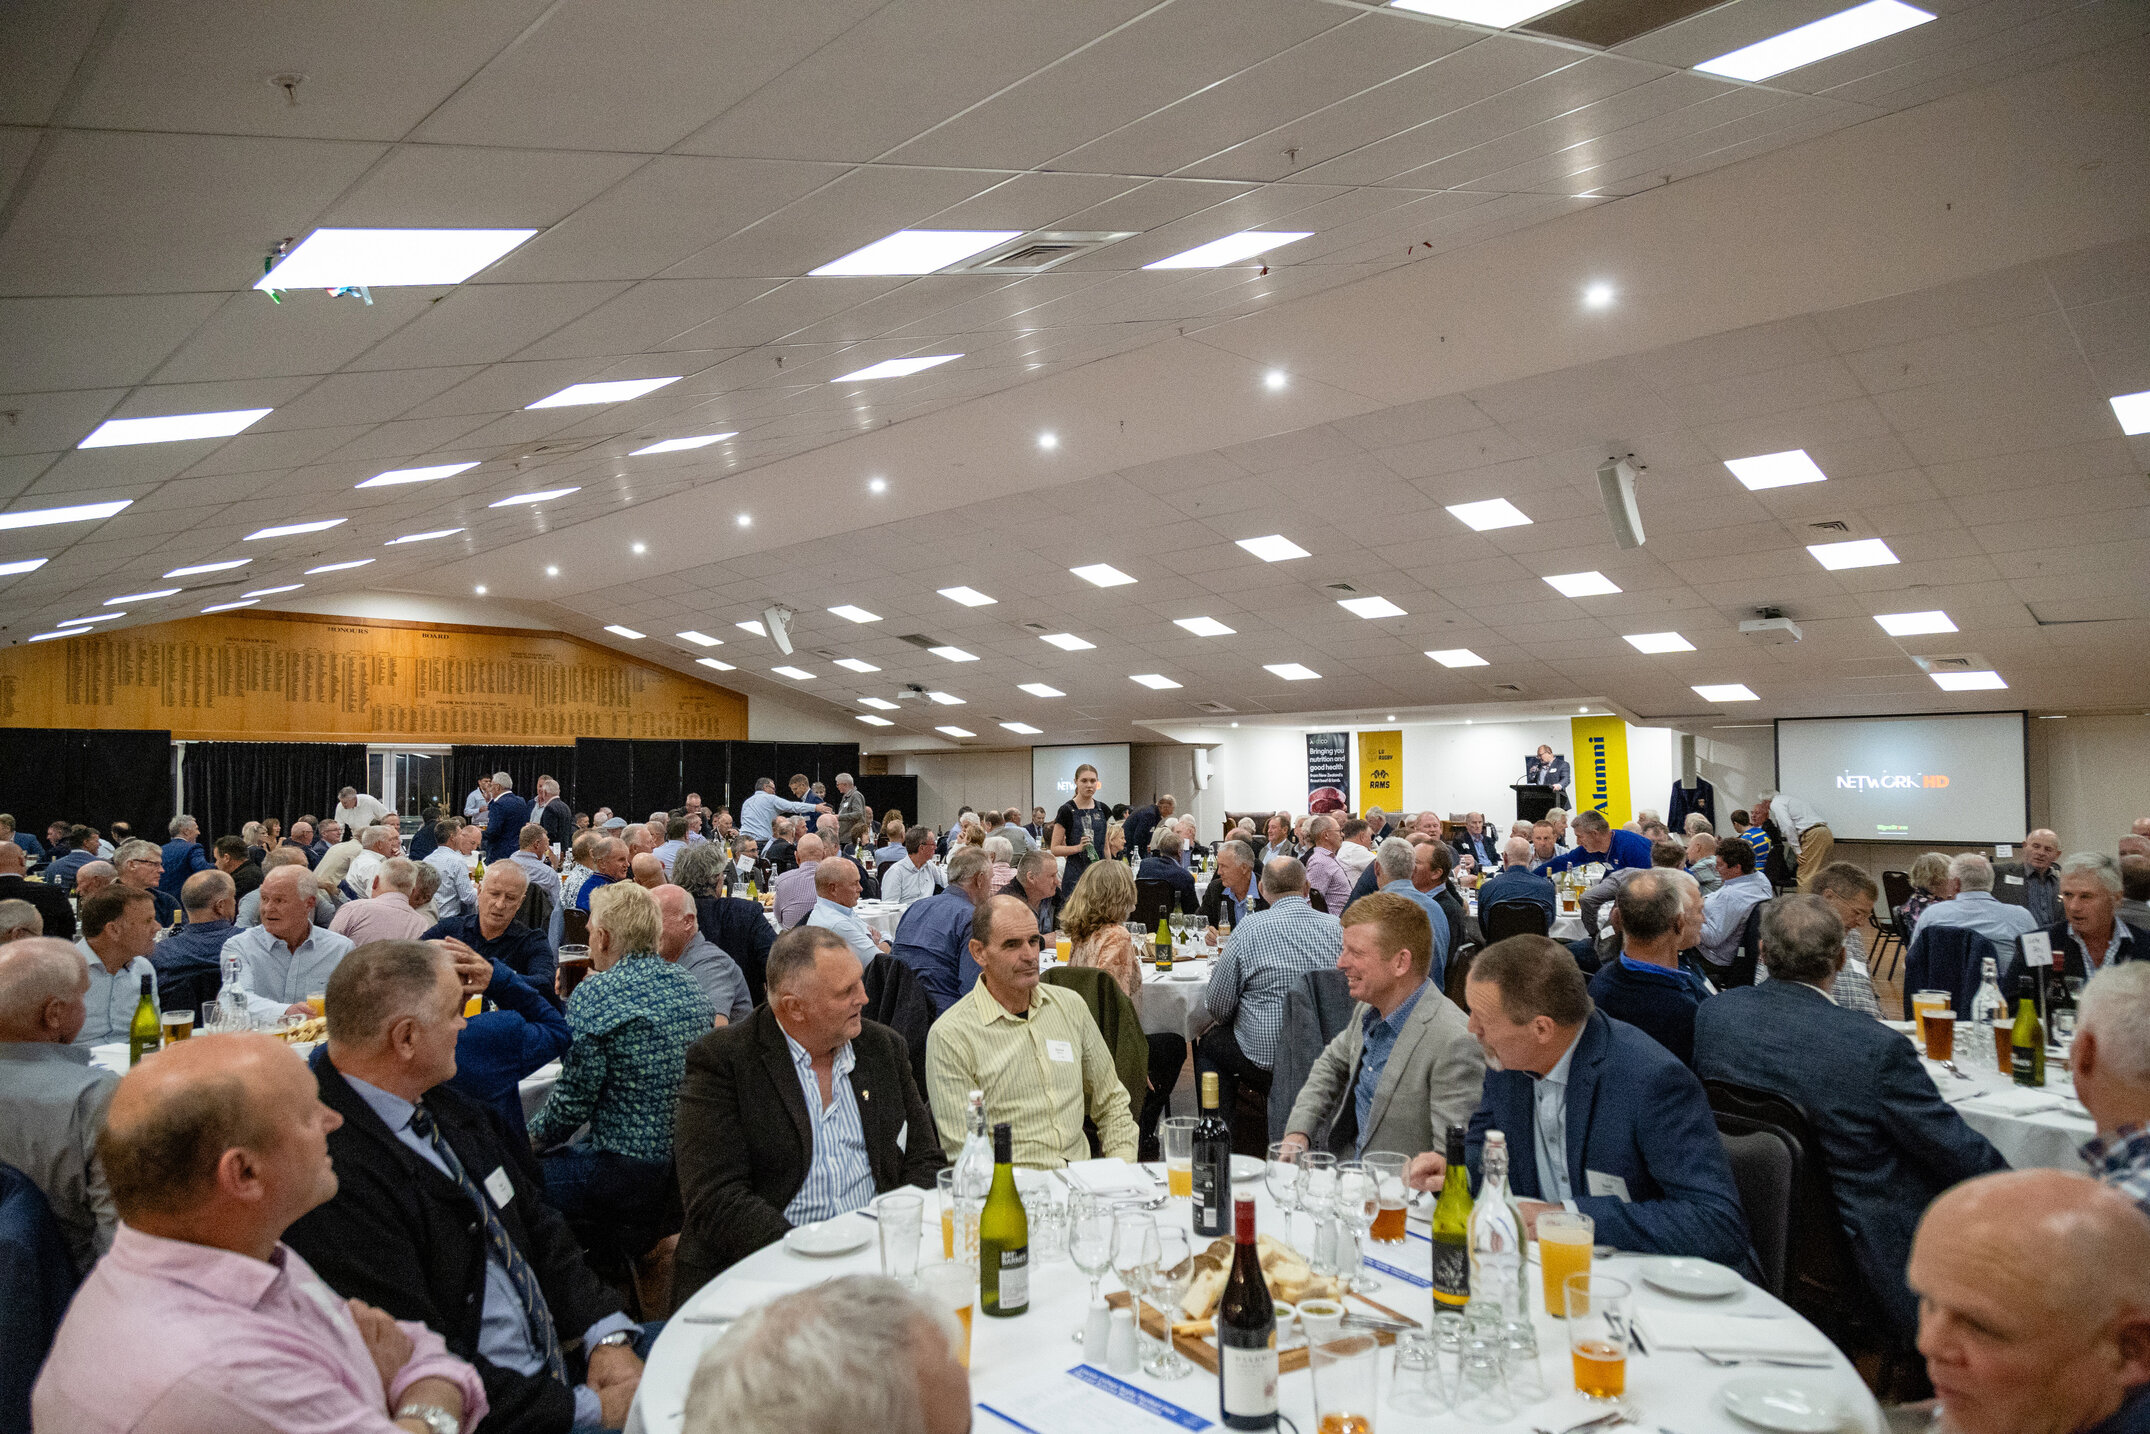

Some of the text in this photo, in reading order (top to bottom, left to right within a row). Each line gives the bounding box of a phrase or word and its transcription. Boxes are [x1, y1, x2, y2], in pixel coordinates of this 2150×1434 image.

[327, 626, 450, 640] HONOURS BOARD
[1309, 748, 1334, 756] Bringing
[1309, 764, 1325, 772] good
[1588, 736, 1609, 815] Alumni
[1836, 772, 1950, 790] NETWORK HD
[1057, 780, 1077, 791] NETW
[1369, 781, 1390, 789] RAMS
